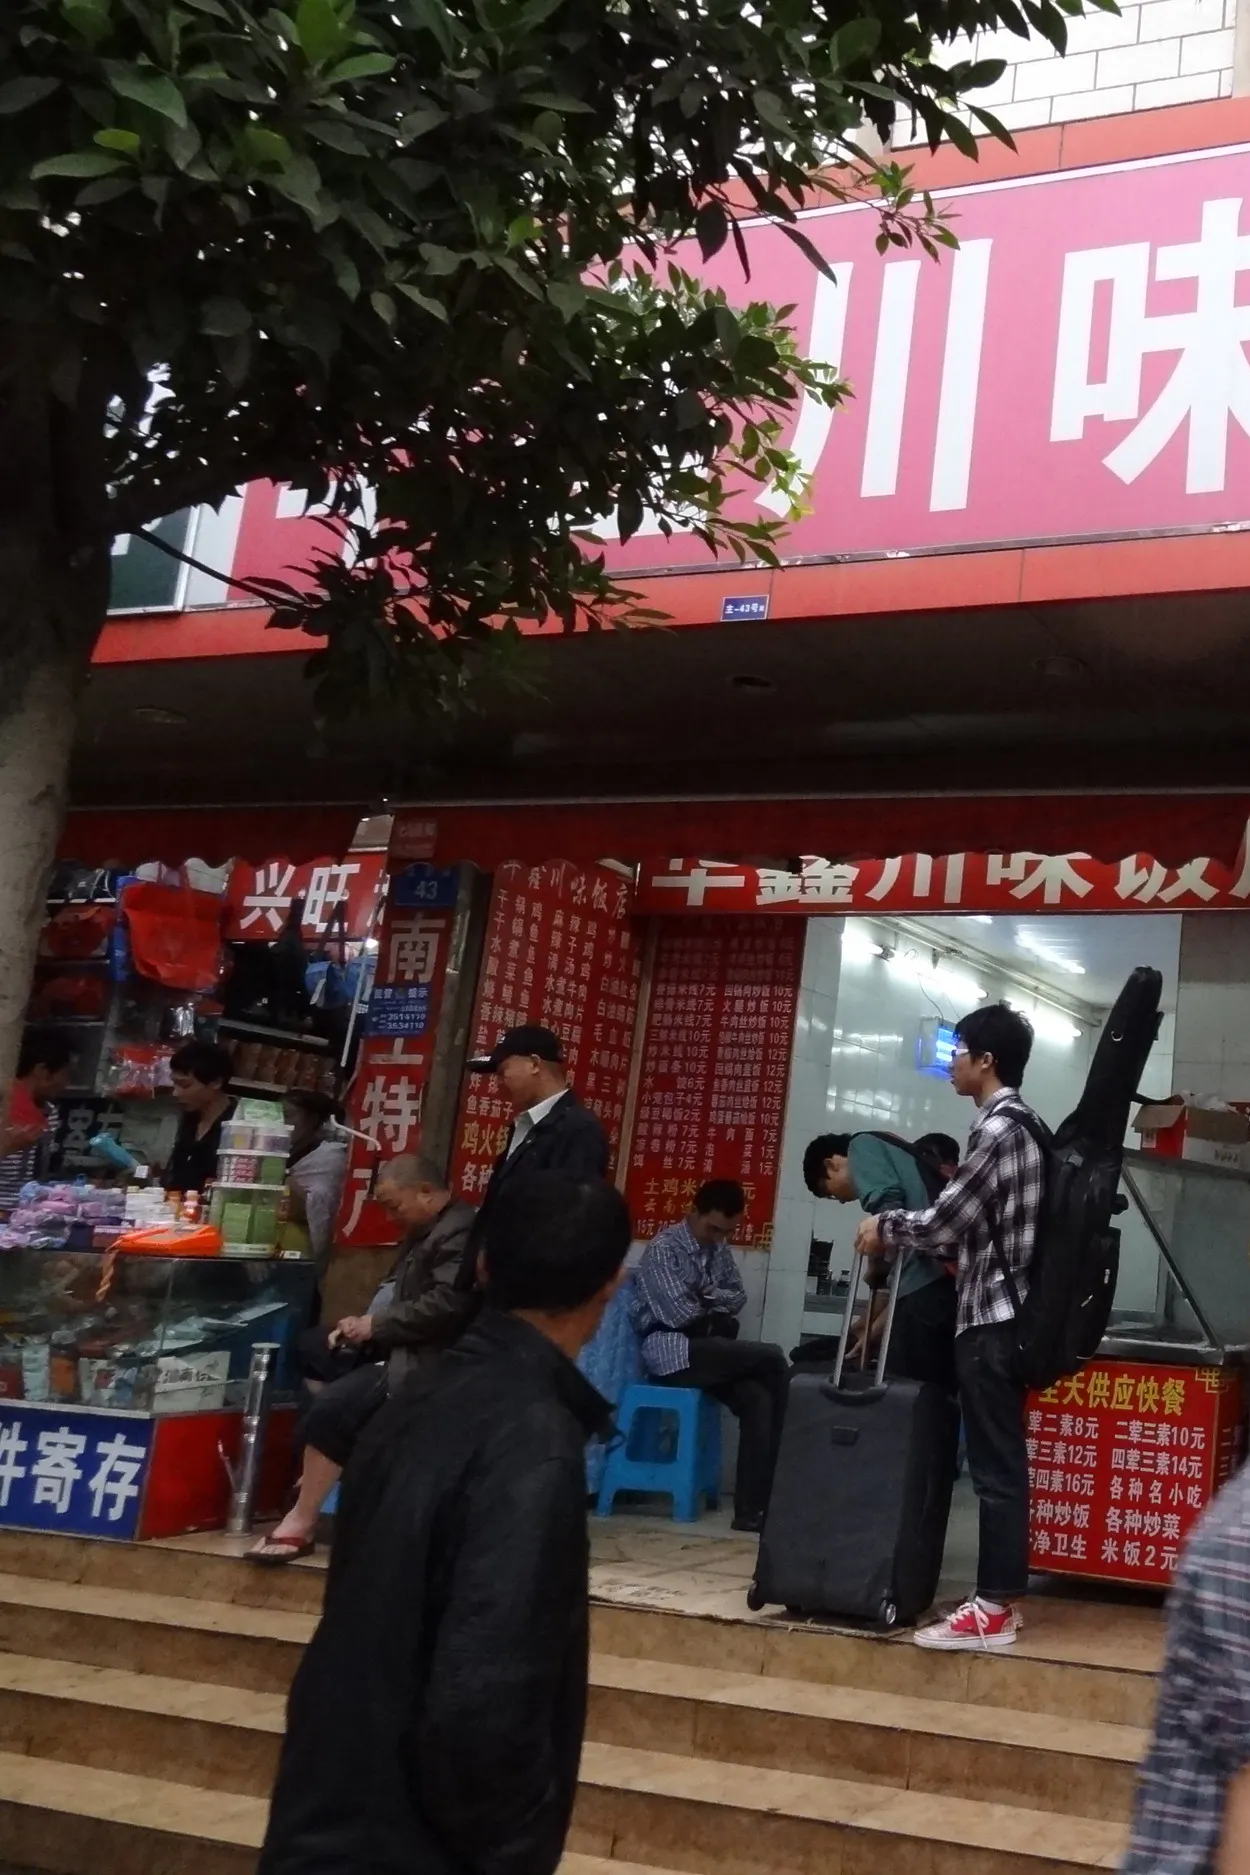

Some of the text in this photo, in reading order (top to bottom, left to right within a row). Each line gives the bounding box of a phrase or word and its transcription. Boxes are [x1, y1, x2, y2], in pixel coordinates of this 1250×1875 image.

[240, 862, 390, 934] 兴旺
[414, 880, 438, 900] 43
[1114, 1419, 1206, 1450] 二荤三素10元
[1111, 1448, 1203, 1478] 四荤三素14元
[1109, 1475, 1203, 1509] 各种名小吃
[1028, 1498, 1181, 1540] 种炒饭 各种炒菜
[1028, 1529, 1179, 1570] 净卫生 米饭2元
